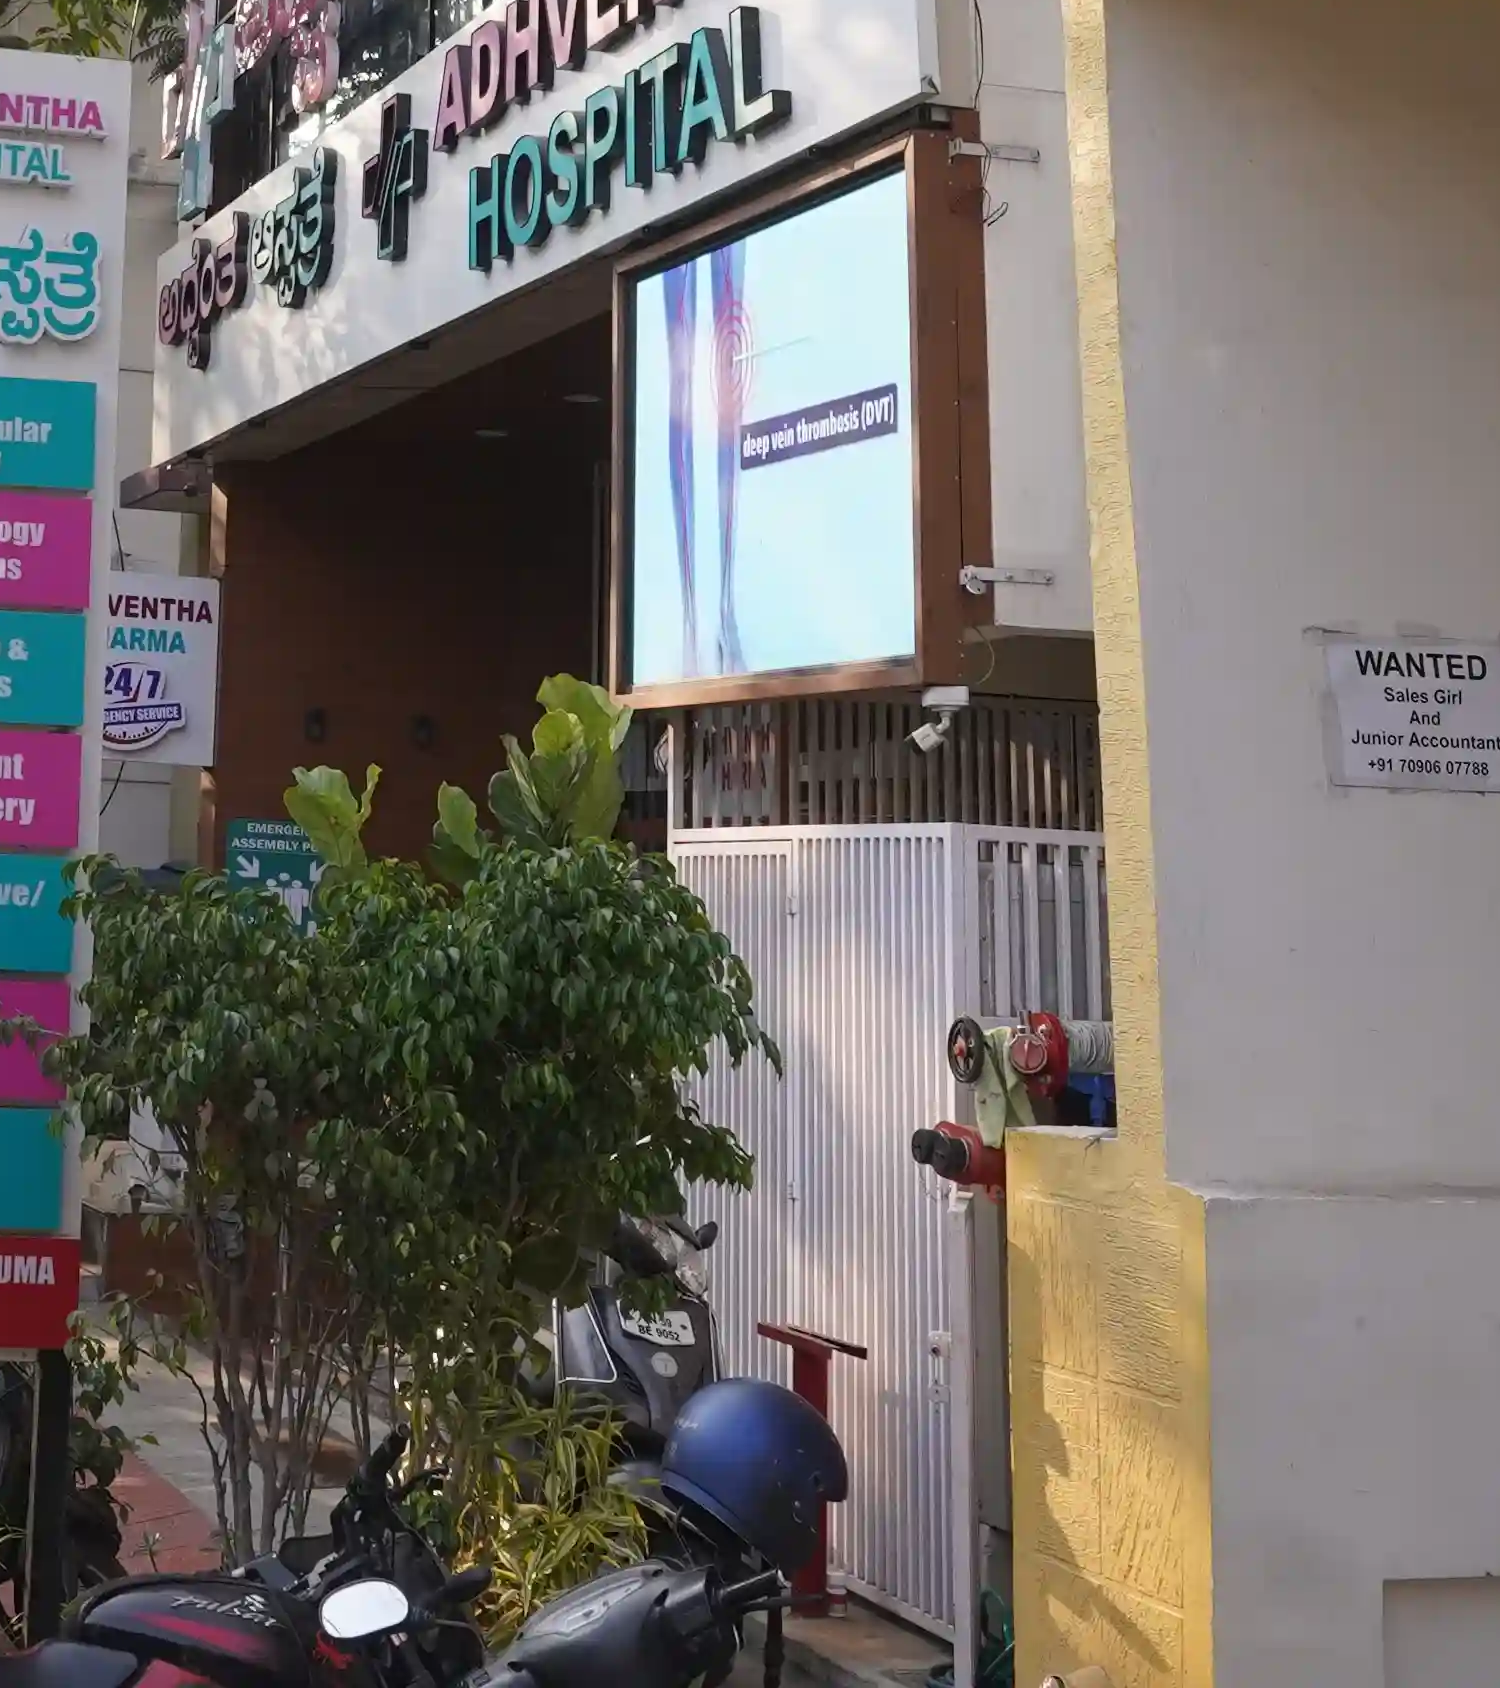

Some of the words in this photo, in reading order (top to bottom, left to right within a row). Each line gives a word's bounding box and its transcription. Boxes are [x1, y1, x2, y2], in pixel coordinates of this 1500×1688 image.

[469, 5, 790, 271] HOSPITAL
[743, 433, 769, 460] deep
[771, 423, 794, 451] vein
[796, 404, 859, 444] thrombosis
[861, 392, 895, 431] (DVT)
[107, 625, 187, 654] ARMA
[7, 637, 29, 662] &
[1355, 649, 1488, 681] WANTED
[104, 665, 162, 700] 24/7
[1383, 686, 1429, 704] Sales
[1433, 690, 1463, 705] Girl
[136, 705, 180, 721] SERVICE
[1409, 709, 1441, 726] And
[1351, 729, 1404, 746] Junior
[1368, 757, 1394, 773] +91
[1400, 758, 1442, 774] 70906
[1446, 761, 1490, 776] 07788
[247, 822, 309, 837] EMERGEN
[231, 837, 300, 851] ASSEMBLY
[638, 1324, 653, 1337] BE
